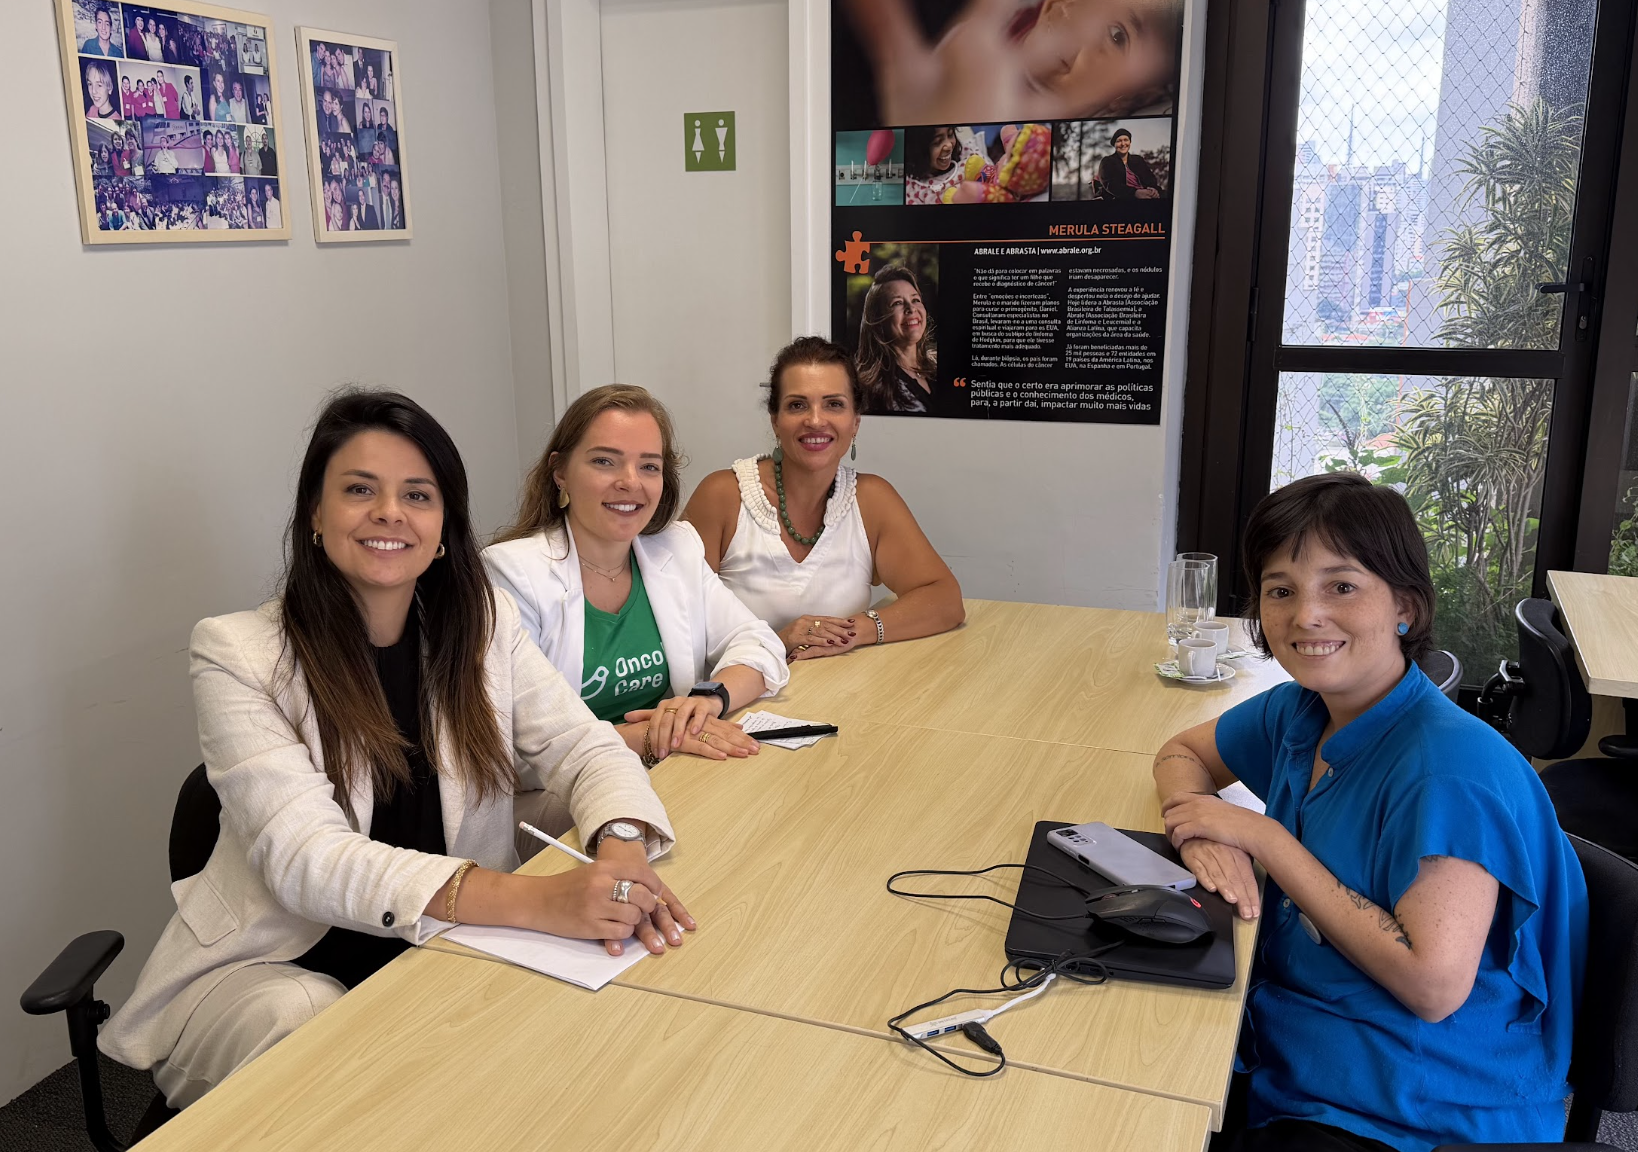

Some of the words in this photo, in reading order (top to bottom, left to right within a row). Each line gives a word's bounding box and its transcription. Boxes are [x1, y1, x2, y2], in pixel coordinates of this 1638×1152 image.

[1049, 224, 1099, 235] MERULA
[1102, 223, 1165, 234] STEAGALL
[1006, 247, 1036, 255] ABRASTA
[1041, 247, 1101, 255] www.abrale.org.br
[971, 380, 996, 389] Sentia
[998, 382, 1012, 390] que
[1060, 383, 1103, 392] aprimorar
[1117, 382, 1153, 393] políticas
[971, 389, 1004, 399] públicas
[1020, 391, 1077, 399] conhecimento
[1097, 392, 1134, 401] médicos,
[971, 400, 990, 408] para,
[1000, 400, 1022, 408] partir
[1041, 400, 1077, 409] impactar
[1107, 402, 1126, 410] mais
[1129, 402, 1151, 411] vidas
[616, 650, 664, 677] Onco
[615, 673, 663, 696] Care
